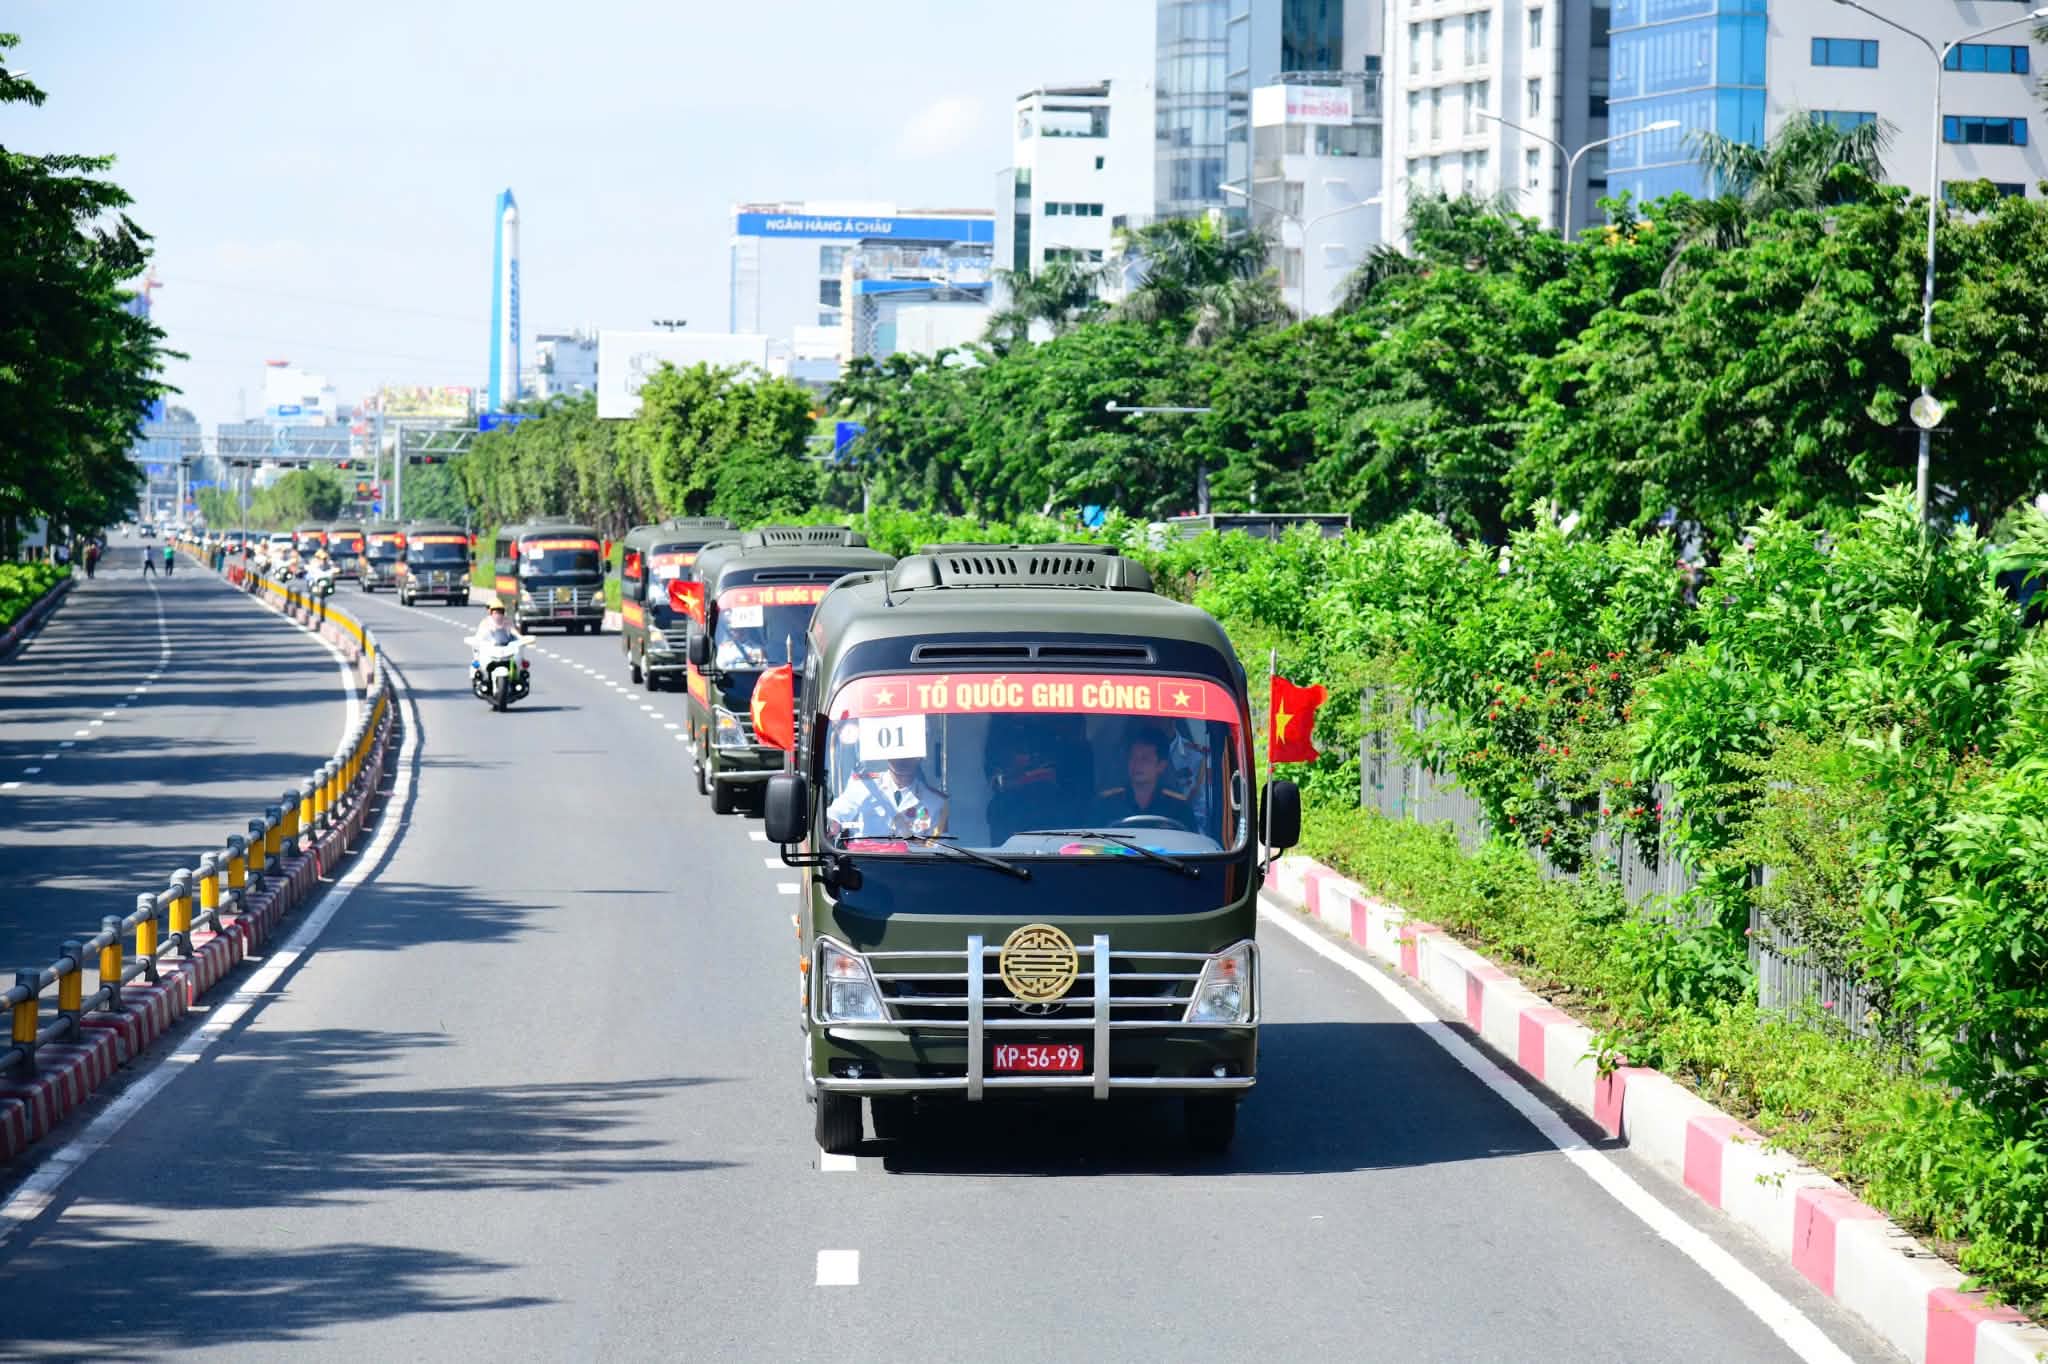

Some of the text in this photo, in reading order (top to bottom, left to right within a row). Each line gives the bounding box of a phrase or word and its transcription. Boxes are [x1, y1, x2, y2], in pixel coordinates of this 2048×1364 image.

[766, 217, 803, 232] NGÂN
[856, 217, 892, 233] CHÂU
[917, 676, 1151, 710] TỔ QUỐC GHI CÔNG
[878, 726, 905, 748] 01
[996, 1047, 1080, 1068] KP-56-99
